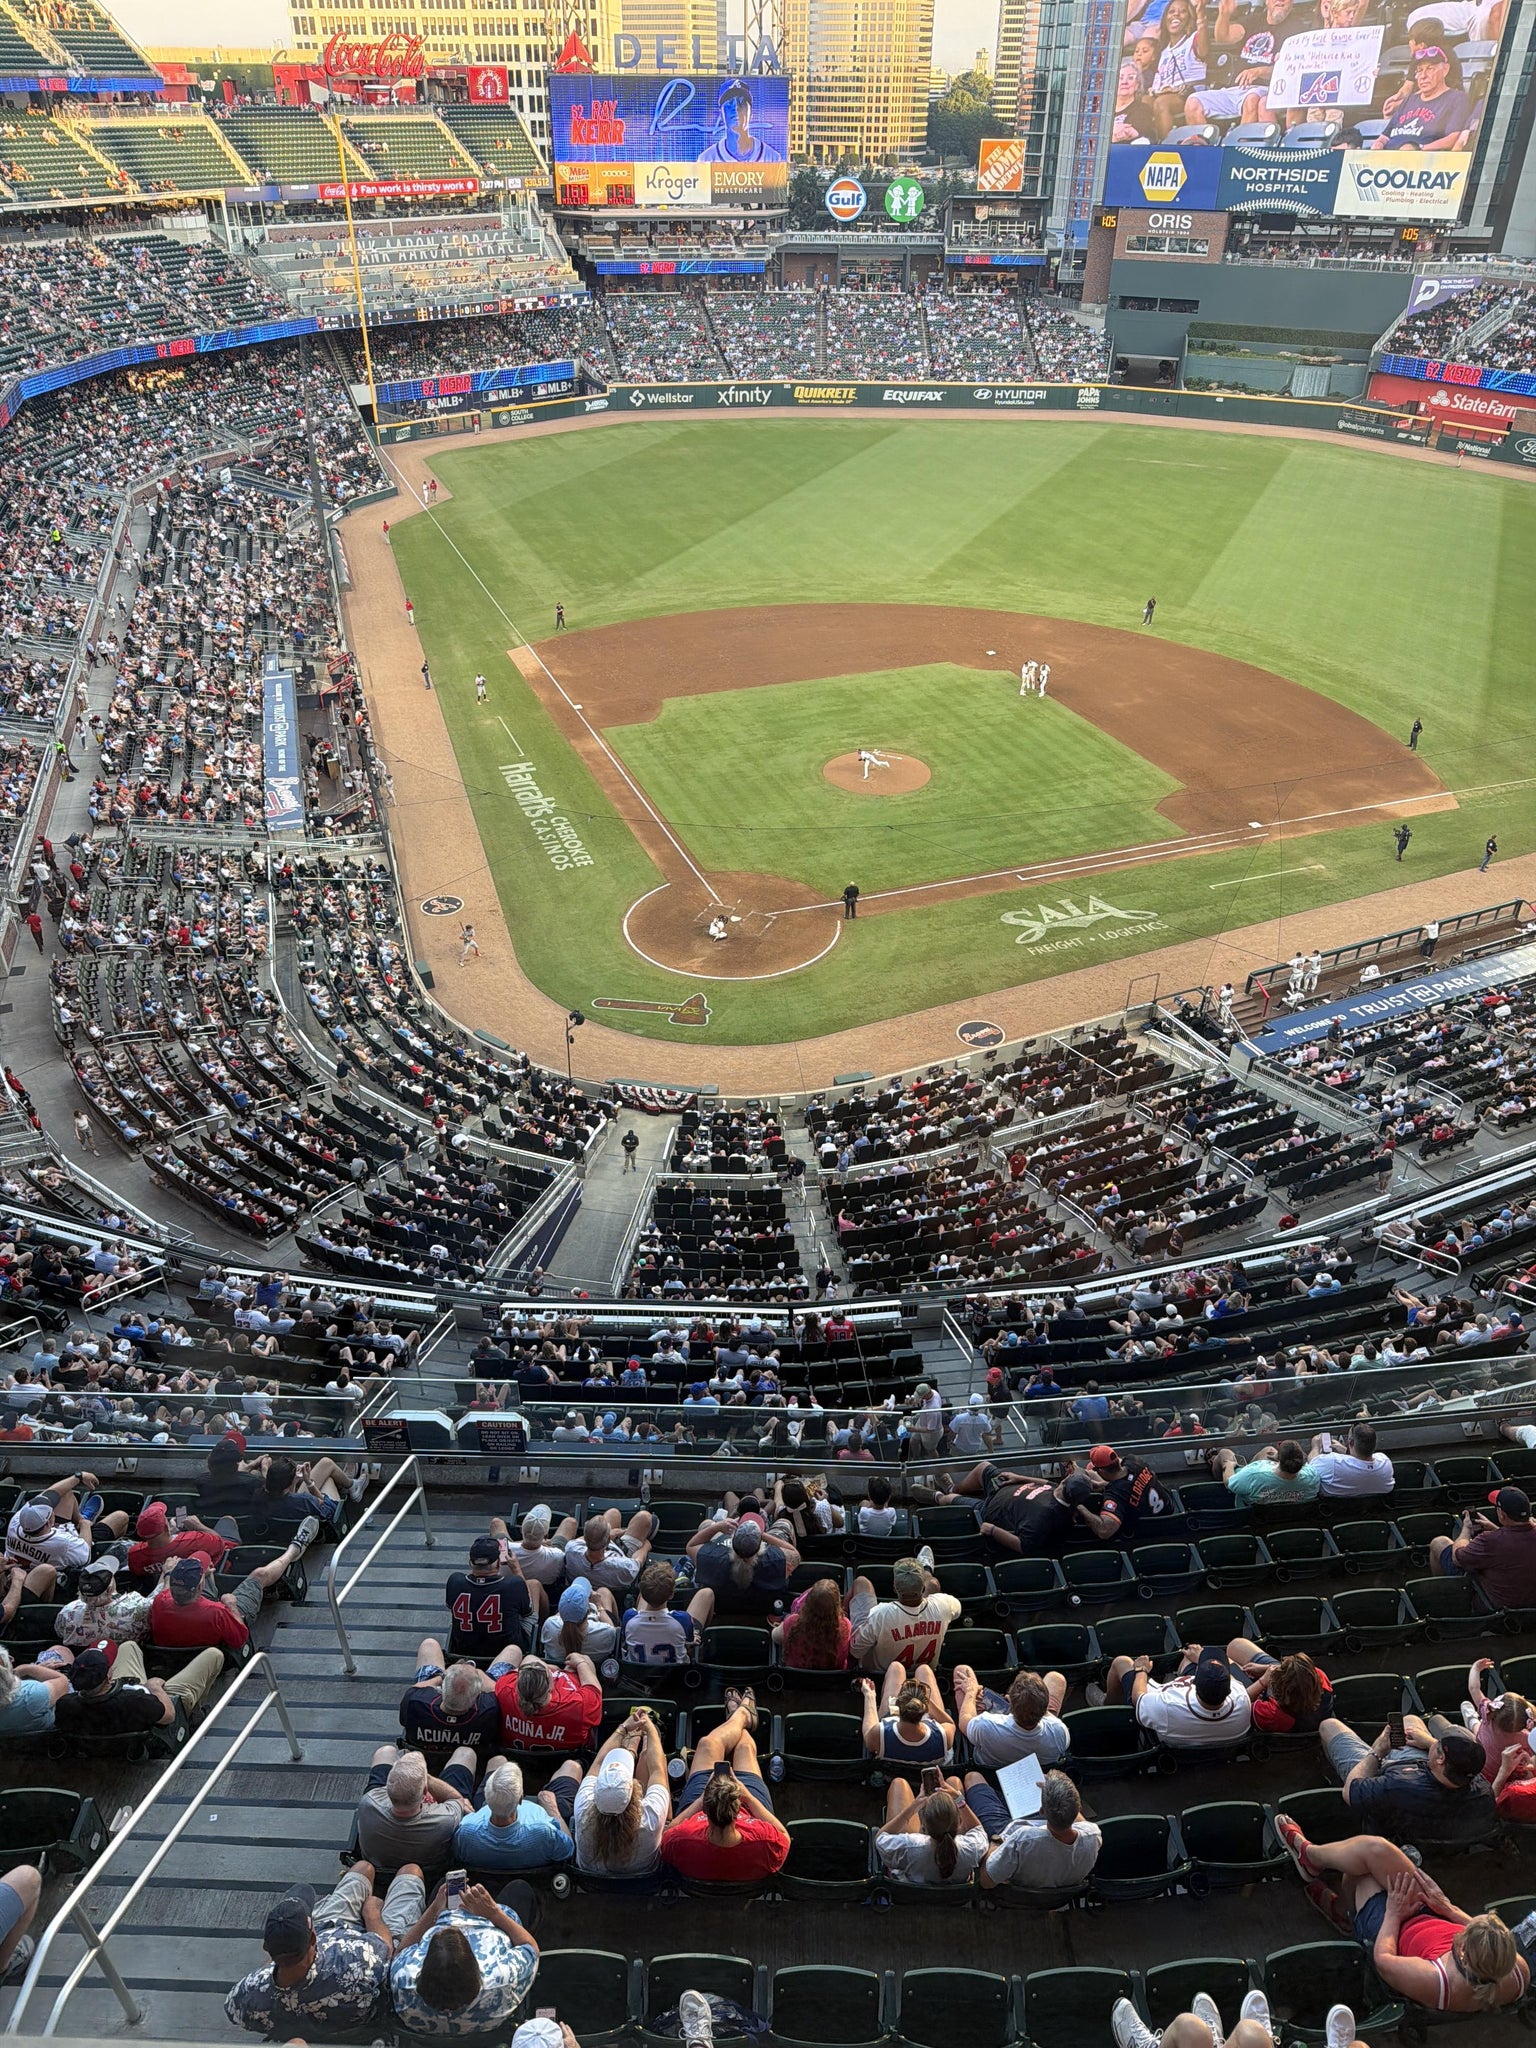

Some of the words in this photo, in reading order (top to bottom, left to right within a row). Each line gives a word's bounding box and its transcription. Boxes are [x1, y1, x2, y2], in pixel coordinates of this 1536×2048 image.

[325, 30, 429, 78] Coca-Cola
[614, 33, 780, 70] DELTA
[570, 104, 584, 119] 62
[591, 100, 618, 121] RAY
[570, 118, 626, 145] KERR
[980, 141, 1025, 191] HOME
[985, 145, 1004, 166] THE
[646, 166, 699, 200] Kroger
[714, 171, 765, 188] EMORY
[995, 161, 1025, 190] DEPOT
[1147, 167, 1180, 188] NAPA
[1230, 167, 1330, 184] NORTHSIDE
[1356, 167, 1461, 190] COOLRAY
[361, 184, 377, 194] Fan
[379, 183, 401, 193] work
[403, 182, 411, 192] is
[412, 181, 444, 194] thirsty
[445, 180, 465, 190] work
[1246, 182, 1308, 194] HOSPITAL
[1381, 190, 1405, 199] Cooling
[828, 192, 863, 207] Gulf
[1385, 197, 1415, 205] Plumbing
[1148, 213, 1193, 229] ORIS
[1426, 362, 1440, 379] 62
[1442, 363, 1483, 387] KERR
[422, 380, 434, 397] 62
[439, 375, 472, 396] KERR
[499, 388, 524, 400] MLB+
[548, 381, 573, 394] MLB+
[717, 385, 773, 406] xfinity
[794, 386, 857, 399] QUIKRETE
[882, 389, 944, 404] EQUIFAX
[995, 389, 1047, 400] HYUNDAI
[1078, 387, 1100, 397] PAPA
[438, 396, 464, 408] MLB+
[647, 392, 694, 404] Wellstar
[1076, 395, 1100, 404] JOHNS
[511, 413, 534, 421] COLLEGE
[1463, 442, 1492, 454] National
[274, 703, 286, 723] TRUIST
[274, 730, 287, 747] PARK
[530, 819, 575, 871] CASINOS
[550, 816, 595, 868] CHEROKEE
[1000, 895, 1158, 944] SAIA
[1027, 937, 1085, 956] FREIGHT
[1098, 920, 1169, 941] LOGISTICS
[1284, 1017, 1332, 1037] WELCOME
[1349, 992, 1413, 1018] TRUIST
[1434, 974, 1481, 995] PARK
[1481, 966, 1510, 978] HOME
[1148, 1487, 1165, 1514] 8
[6, 1536, 51, 1564] SWANSON
[452, 1592, 503, 1633] 44
[891, 1620, 942, 1642] H.AARON
[894, 1639, 937, 1671] 44
[416, 1726, 461, 1745] ACUÑA
[462, 1732, 481, 1745] JR.
[505, 1714, 544, 1739] ACUÑA
[546, 1725, 566, 1742] JR.
